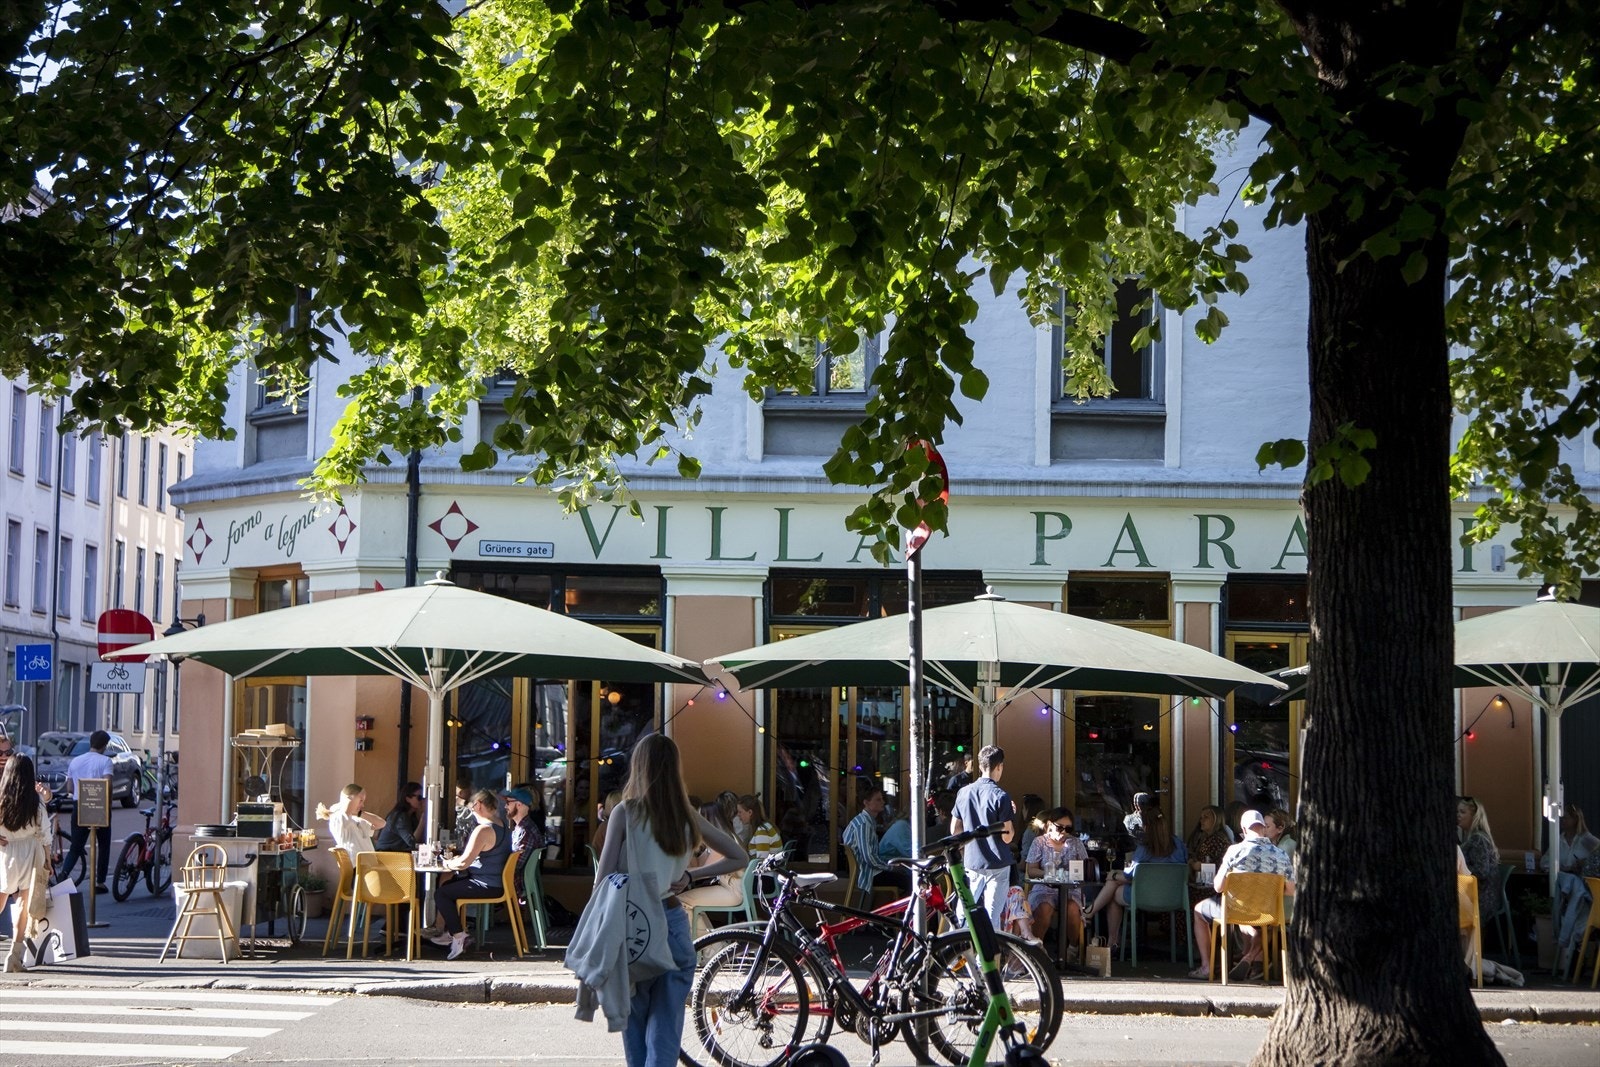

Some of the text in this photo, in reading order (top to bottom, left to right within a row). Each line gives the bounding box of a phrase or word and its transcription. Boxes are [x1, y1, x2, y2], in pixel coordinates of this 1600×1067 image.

[222, 506, 317, 565] forno a legna
[485, 543, 548, 556] Grüners gate
